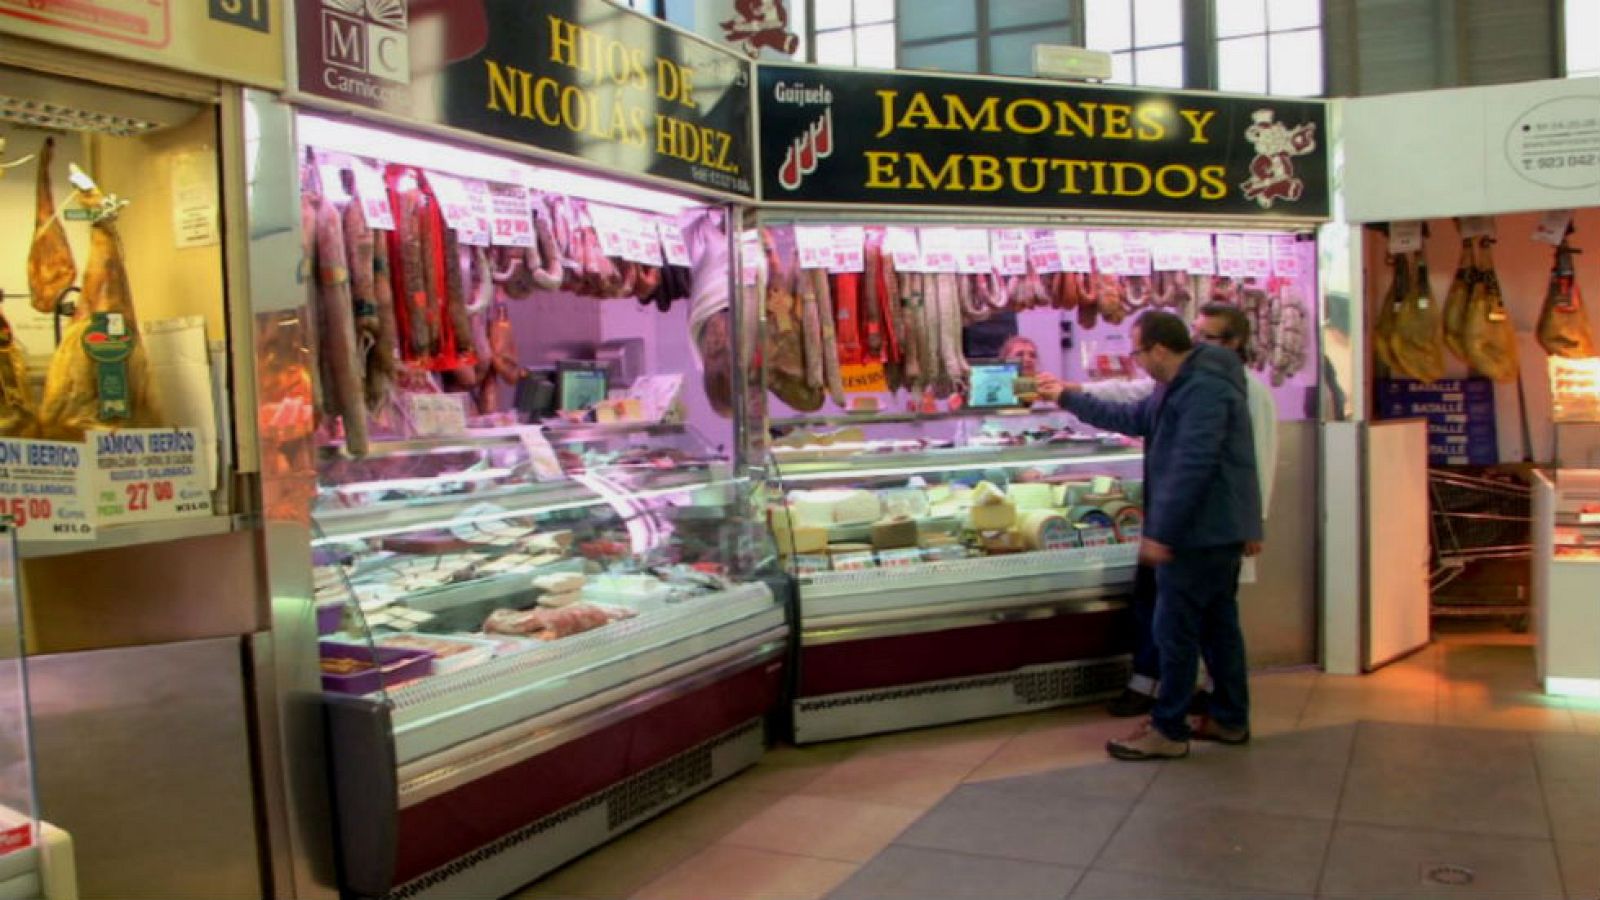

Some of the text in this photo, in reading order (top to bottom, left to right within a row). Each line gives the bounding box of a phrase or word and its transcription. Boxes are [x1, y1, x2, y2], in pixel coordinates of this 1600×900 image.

[546, 13, 648, 90] HIJOS
[655, 56, 697, 109] DE
[485, 58, 647, 146] NICOLÁS
[875, 89, 1216, 144] JAMONES Y
[863, 150, 1228, 200] EMBUTIDOS
[126, 482, 149, 511] 27
[53, 523, 91, 534] KILO
